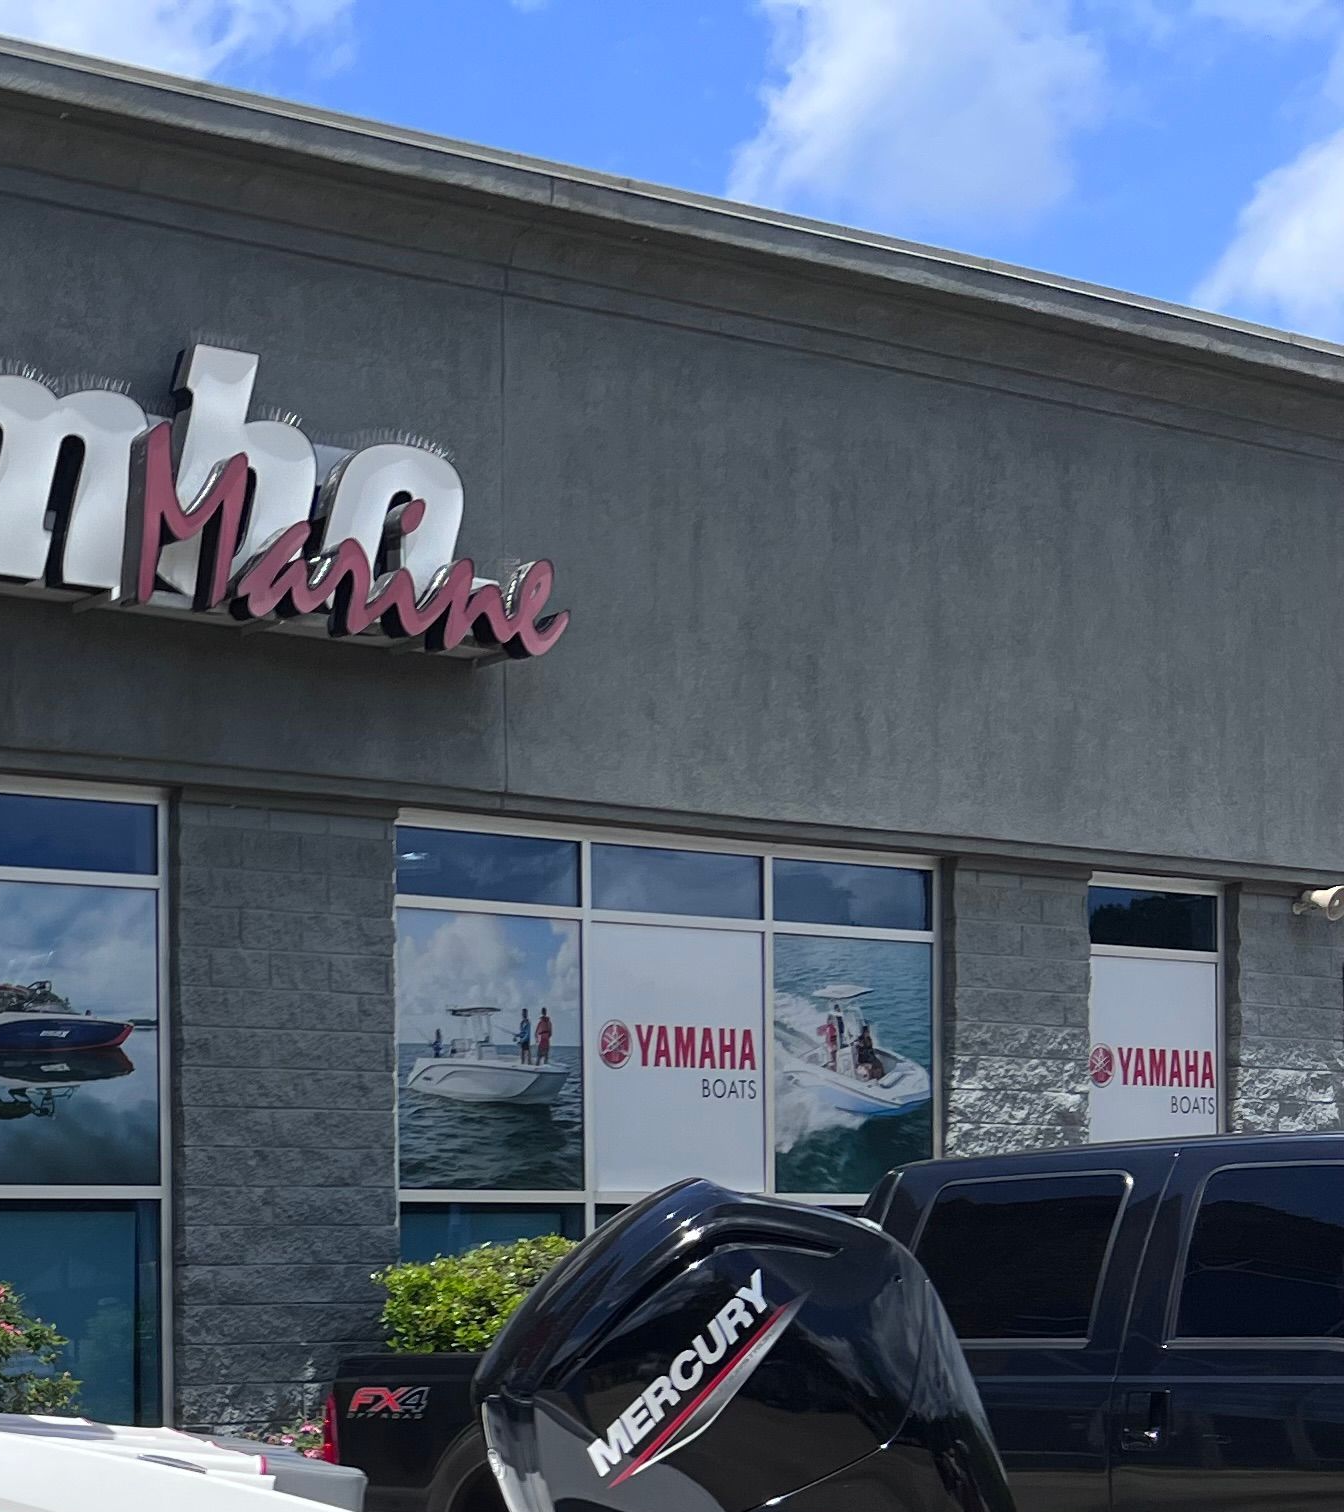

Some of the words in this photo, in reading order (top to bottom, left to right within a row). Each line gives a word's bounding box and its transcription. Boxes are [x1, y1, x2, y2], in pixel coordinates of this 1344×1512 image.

[129, 420, 572, 660] Marine
[635, 1024, 757, 1071] YAMAHA
[1117, 1047, 1215, 1089] YAMAHA
[701, 1078, 757, 1100] BOATS
[1170, 1095, 1216, 1115] BOATS
[586, 1268, 768, 1478] MERCURY
[348, 1386, 431, 1413] FX4
